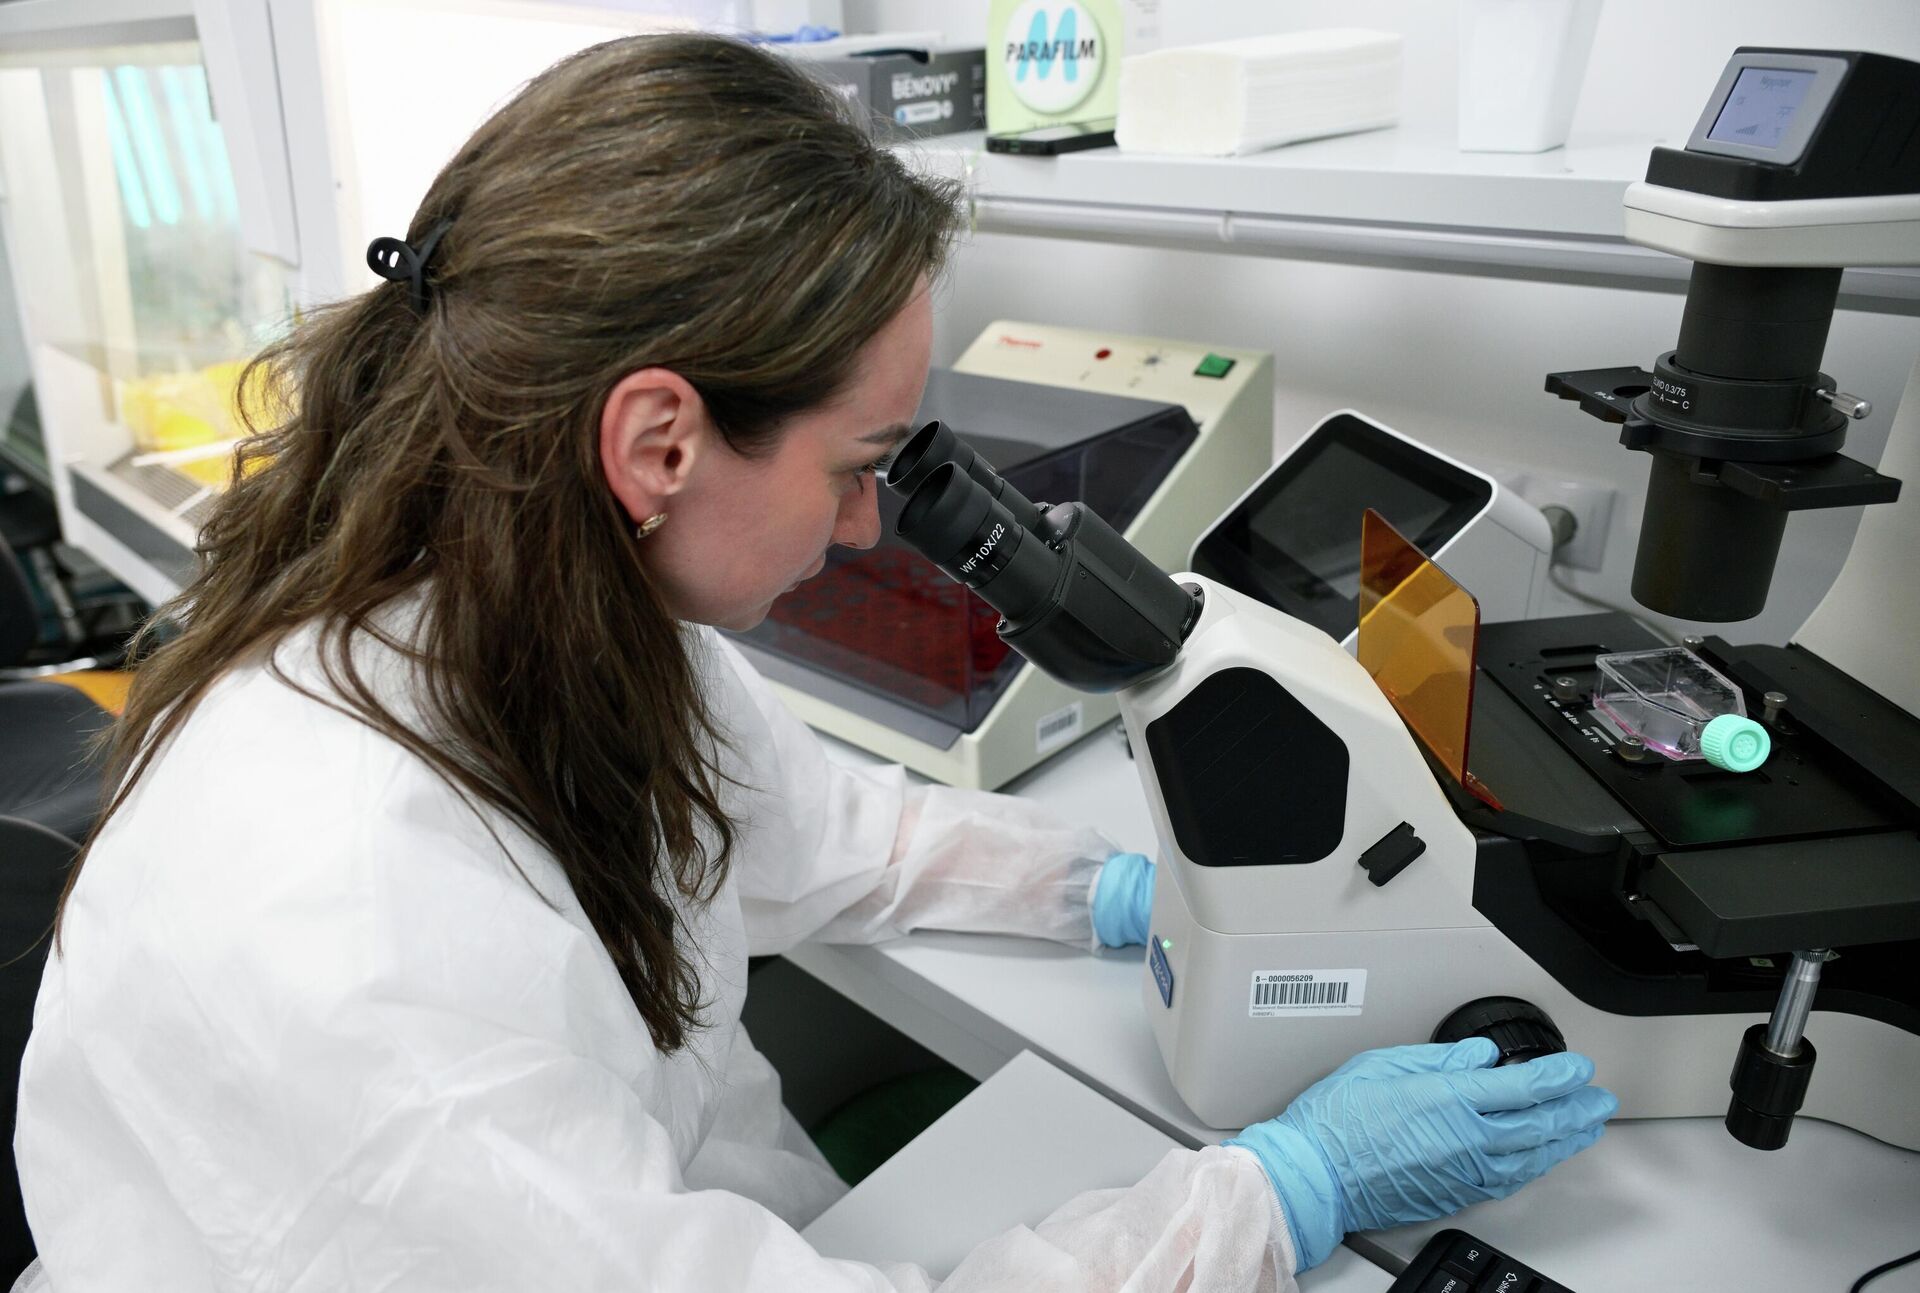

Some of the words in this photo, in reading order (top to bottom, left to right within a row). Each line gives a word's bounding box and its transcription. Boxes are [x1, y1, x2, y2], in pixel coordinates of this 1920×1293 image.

[1006, 39, 1096, 62] PARAFILM
[1665, 384, 1687, 397] 0.3/75
[1682, 400, 1690, 410] C
[1467, 1250, 1479, 1261] Ctrl
